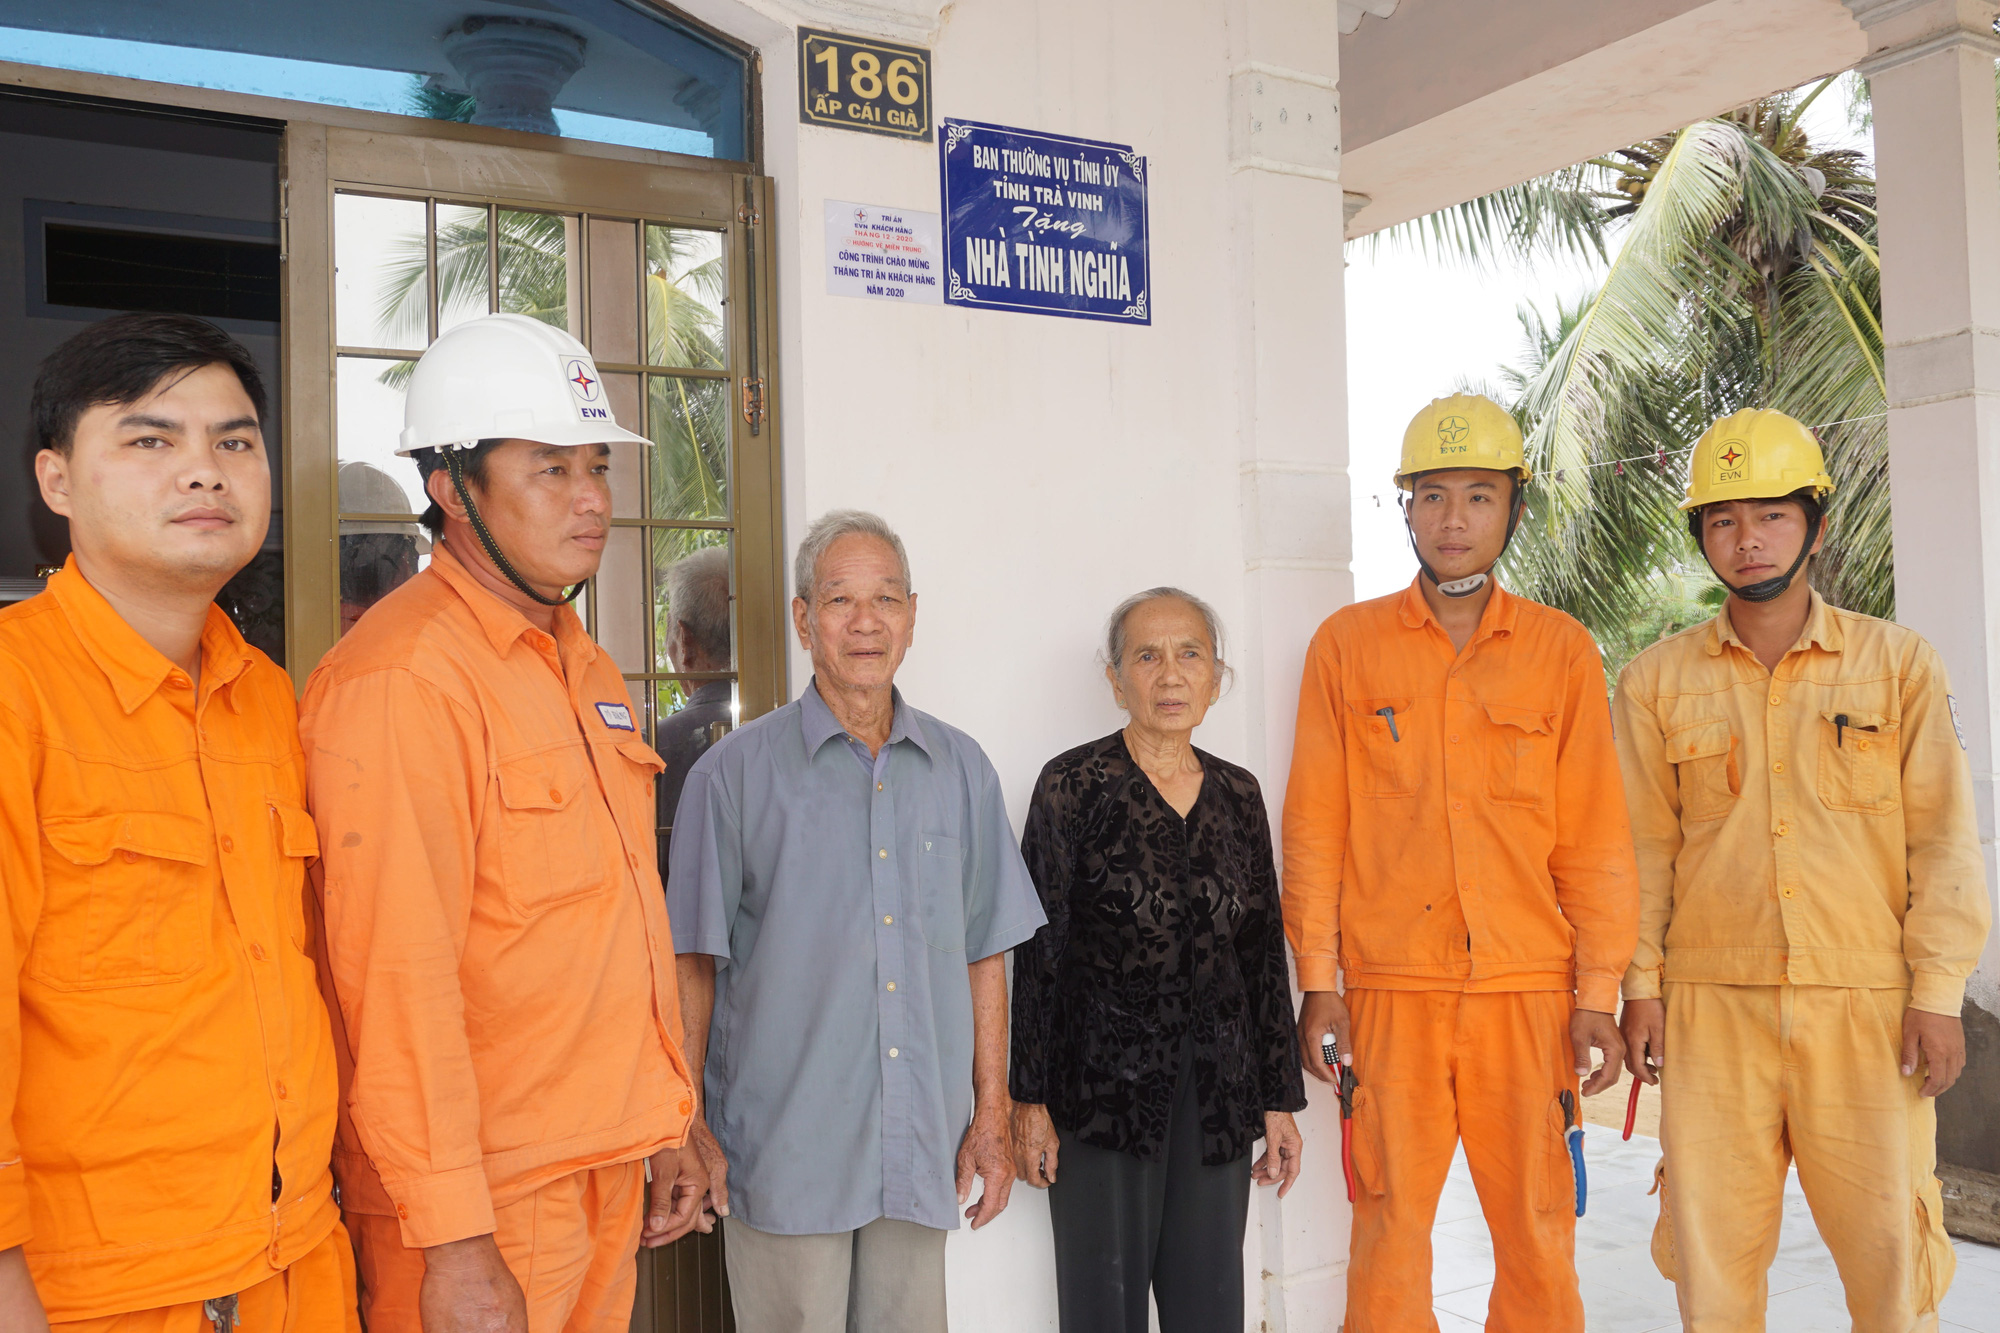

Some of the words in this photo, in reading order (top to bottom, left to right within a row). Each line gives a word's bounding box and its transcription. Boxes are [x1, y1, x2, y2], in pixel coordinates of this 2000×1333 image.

[815, 45, 919, 106] 186
[814, 93, 842, 115] ẤP
[848, 102, 881, 122] CÁI
[887, 109, 918, 128] GIÀ
[973, 145, 998, 171] BAN
[1002, 146, 1051, 178] THƯỜNG
[1053, 157, 1069, 186] VỤ
[1073, 152, 1100, 185] TỈNH
[1104, 156, 1119, 187] ỦY
[993, 175, 1029, 202] TỈNH
[1034, 185, 1063, 206] TRÀ
[1067, 191, 1103, 211] VINH
[872, 224, 894, 232] KHÁCH
[895, 226, 913, 234] HÀNG
[1012, 206, 1087, 239] Tặng
[854, 229, 881, 238] THÁNG
[838, 249, 859, 262] CÔNG
[861, 252, 884, 265] TRÌNH
[886, 255, 906, 267] CHÀO
[908, 257, 930, 270] MỪNG
[966, 227, 1011, 288] NHÀ
[1015, 231, 1064, 294] TÌNH
[1070, 241, 1131, 301] NGHĨA
[833, 265, 859, 278] THÁNG
[861, 269, 874, 279] TRI
[875, 269, 886, 280] ÂN
[888, 271, 913, 283] KHÁCH
[916, 273, 935, 286] HÀNG
[866, 283, 884, 296] NĂM
[886, 287, 905, 298] 2020
[581, 408, 607, 418] EVN
[1440, 445, 1467, 454] EVN
[1720, 470, 1742, 481] EVN
